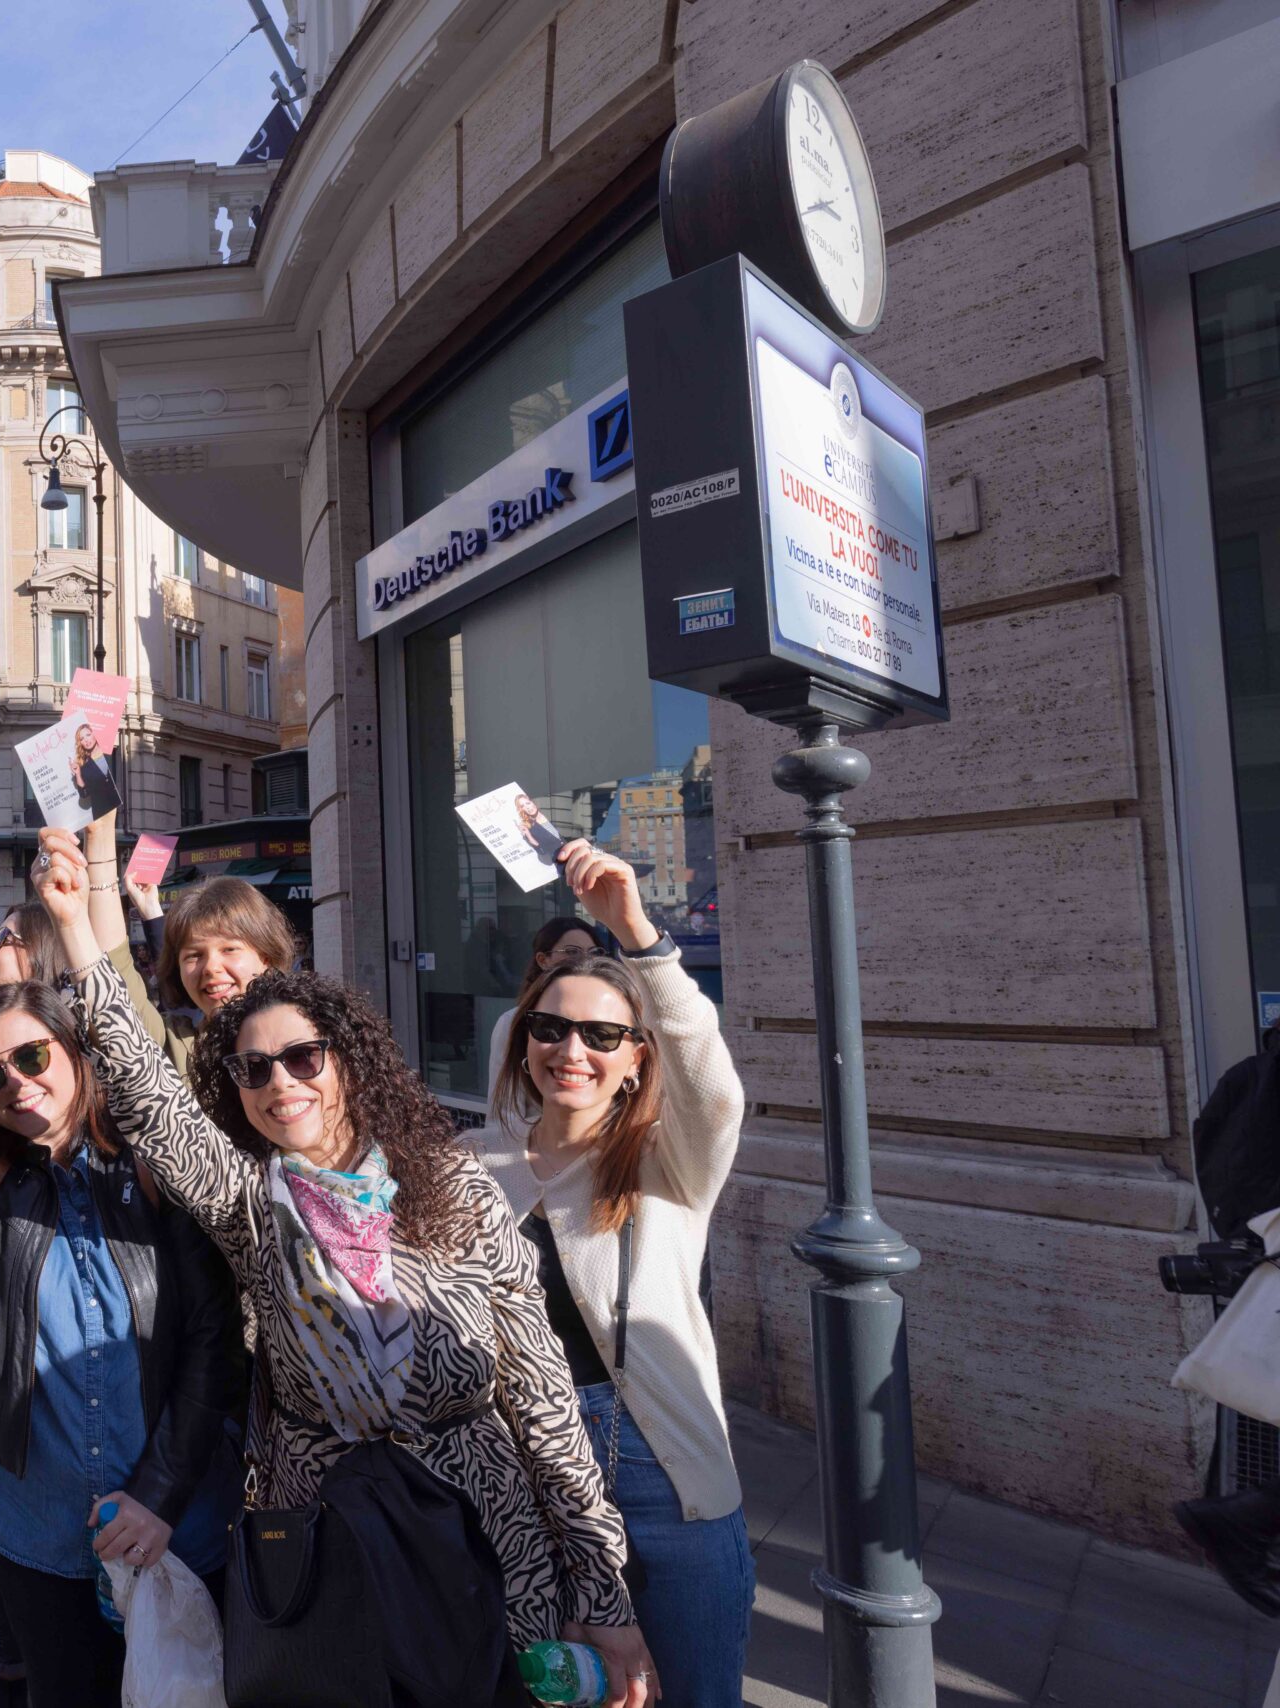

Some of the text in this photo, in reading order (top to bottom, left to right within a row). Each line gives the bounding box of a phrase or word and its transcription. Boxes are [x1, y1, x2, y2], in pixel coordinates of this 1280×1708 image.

[803, 95, 822, 135] 12
[850, 225, 860, 253] 3
[651, 478, 736, 509] 0020/AC108/P
[824, 454, 877, 506] eCAMPUS
[372, 467, 577, 612] Deutsche Bank
[781, 468, 866, 543] L'UNIVERSITÀ
[868, 525, 901, 563] COME
[902, 544, 918, 572] TU
[786, 536, 923, 623] Vicina a te e con tutor personale.
[829, 531, 883, 582] LA VUOI.
[806, 591, 822, 614] Via
[822, 598, 850, 626] Matera
[851, 613, 861, 632] 18
[873, 623, 883, 641] Re
[884, 627, 892, 646] di
[892, 632, 913, 655] Roma
[827, 626, 902, 672] Chiama 800 27 17 89
[220, 847, 242, 859] ROME
